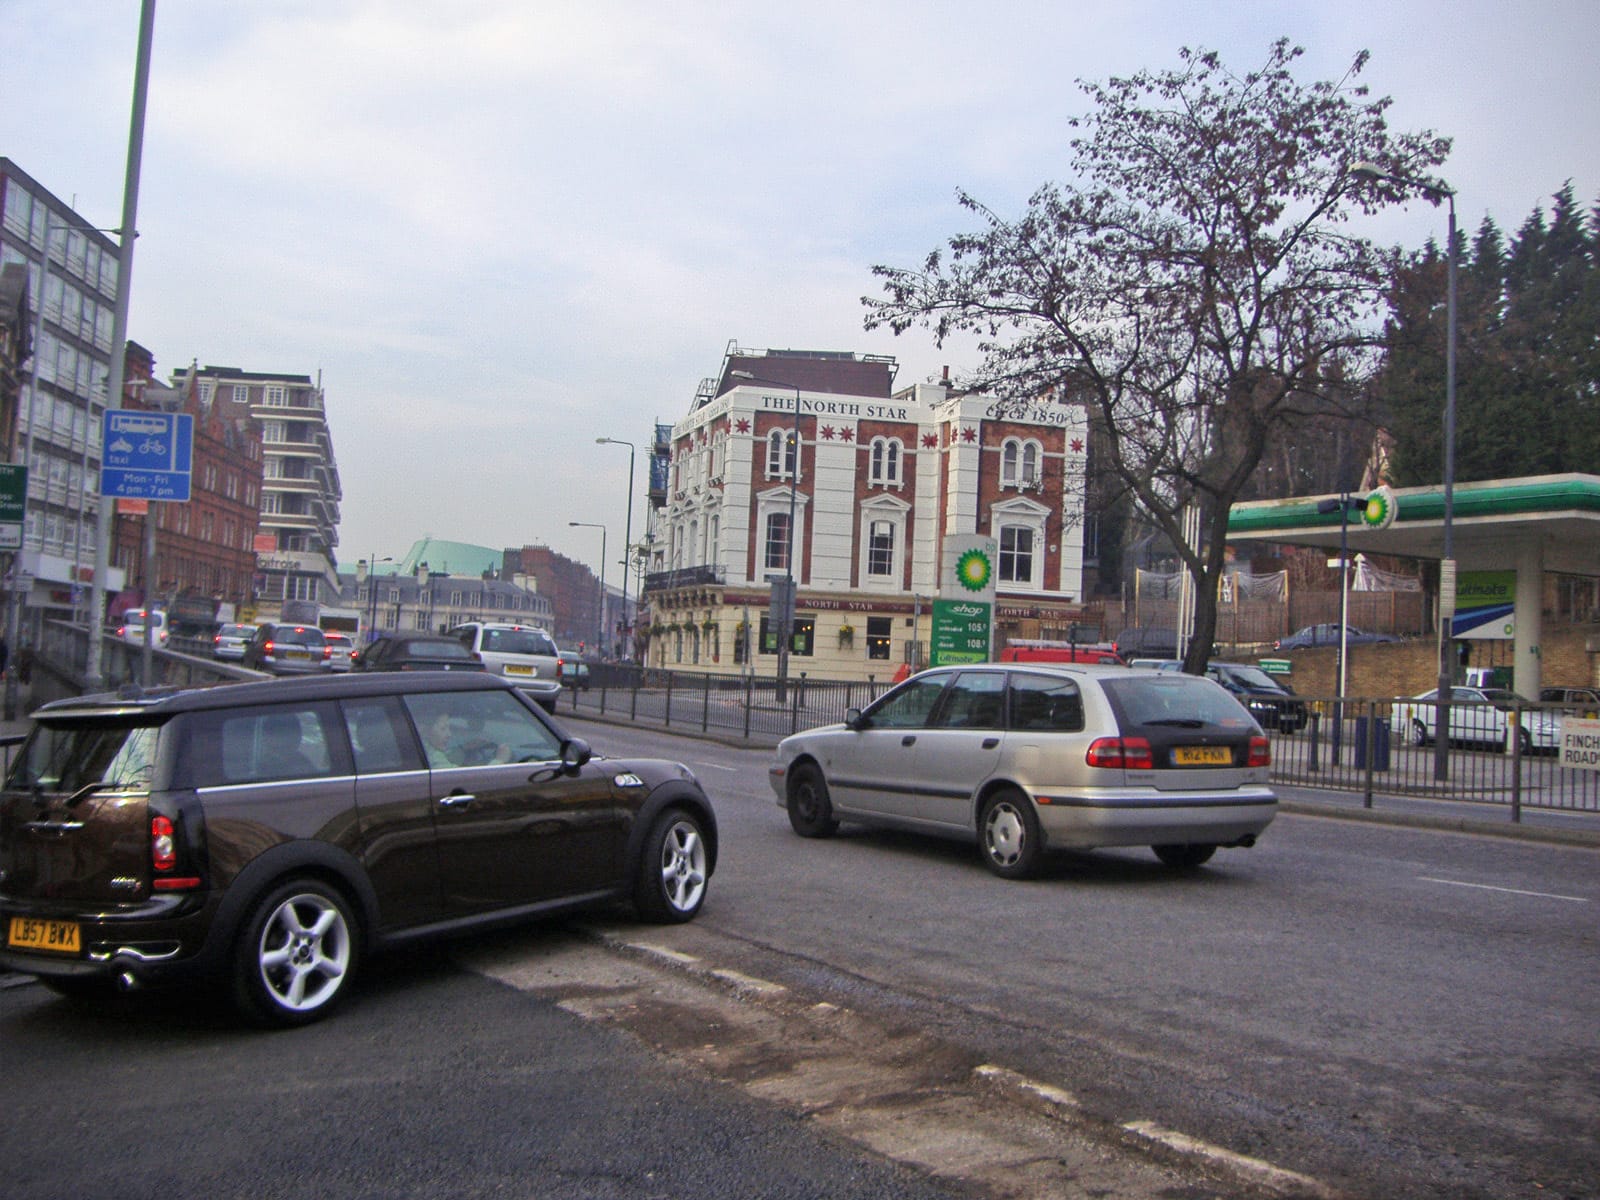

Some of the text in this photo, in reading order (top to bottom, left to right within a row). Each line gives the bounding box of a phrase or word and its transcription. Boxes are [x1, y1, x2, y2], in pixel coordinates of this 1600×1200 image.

[762, 396, 907, 421] THE NORTH STAR
[1032, 410, 1065, 425] 1850
[109, 454, 129, 465] taxi
[123, 473, 147, 484] Mon
[154, 474, 169, 485] Fri
[805, 600, 873, 611] NORTH STAR
[952, 603, 983, 616] shop
[1565, 734, 1600, 749] FINCH
[1565, 750, 1597, 765] ROAD
